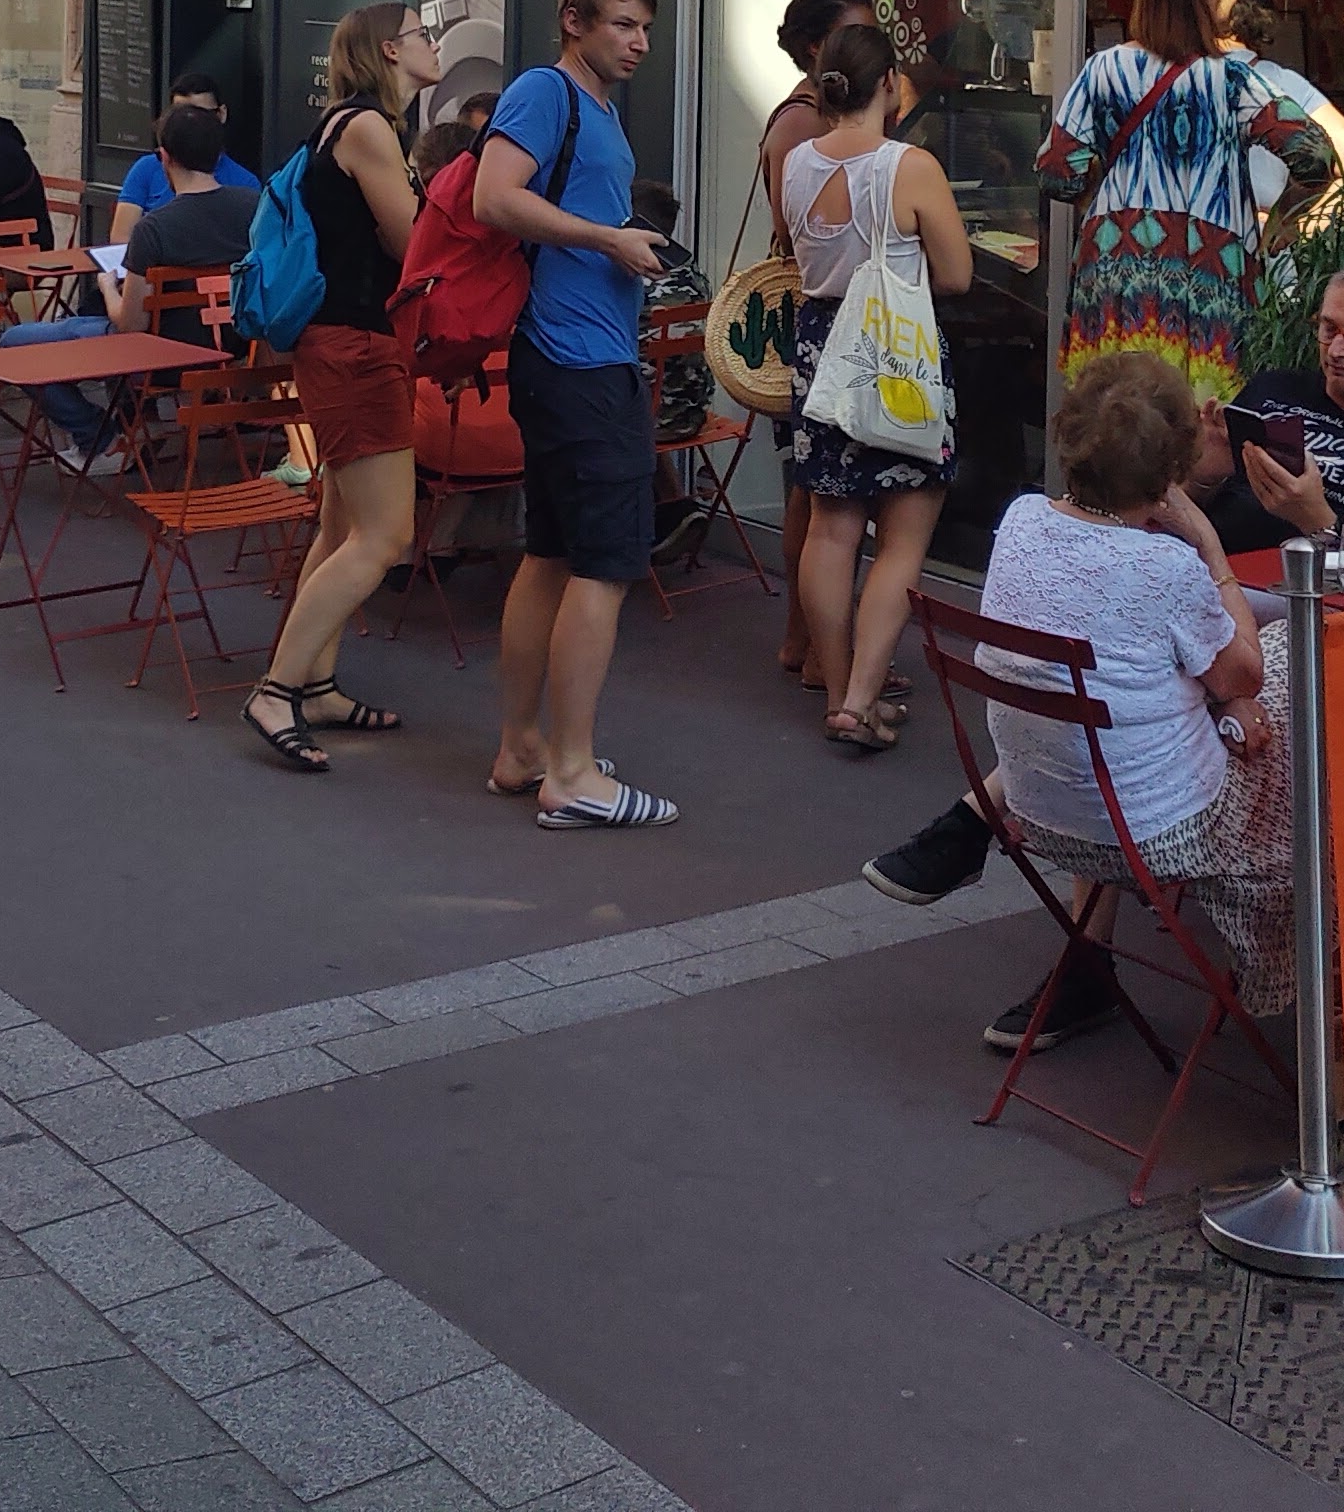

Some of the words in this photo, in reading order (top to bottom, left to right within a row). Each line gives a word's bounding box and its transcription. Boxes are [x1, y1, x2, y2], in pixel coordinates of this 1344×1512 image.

[862, 296, 939, 366] RIEN
[880, 347, 913, 380] dans
[916, 358, 929, 381] le
[1289, 406, 1344, 429] ORIGINAL
